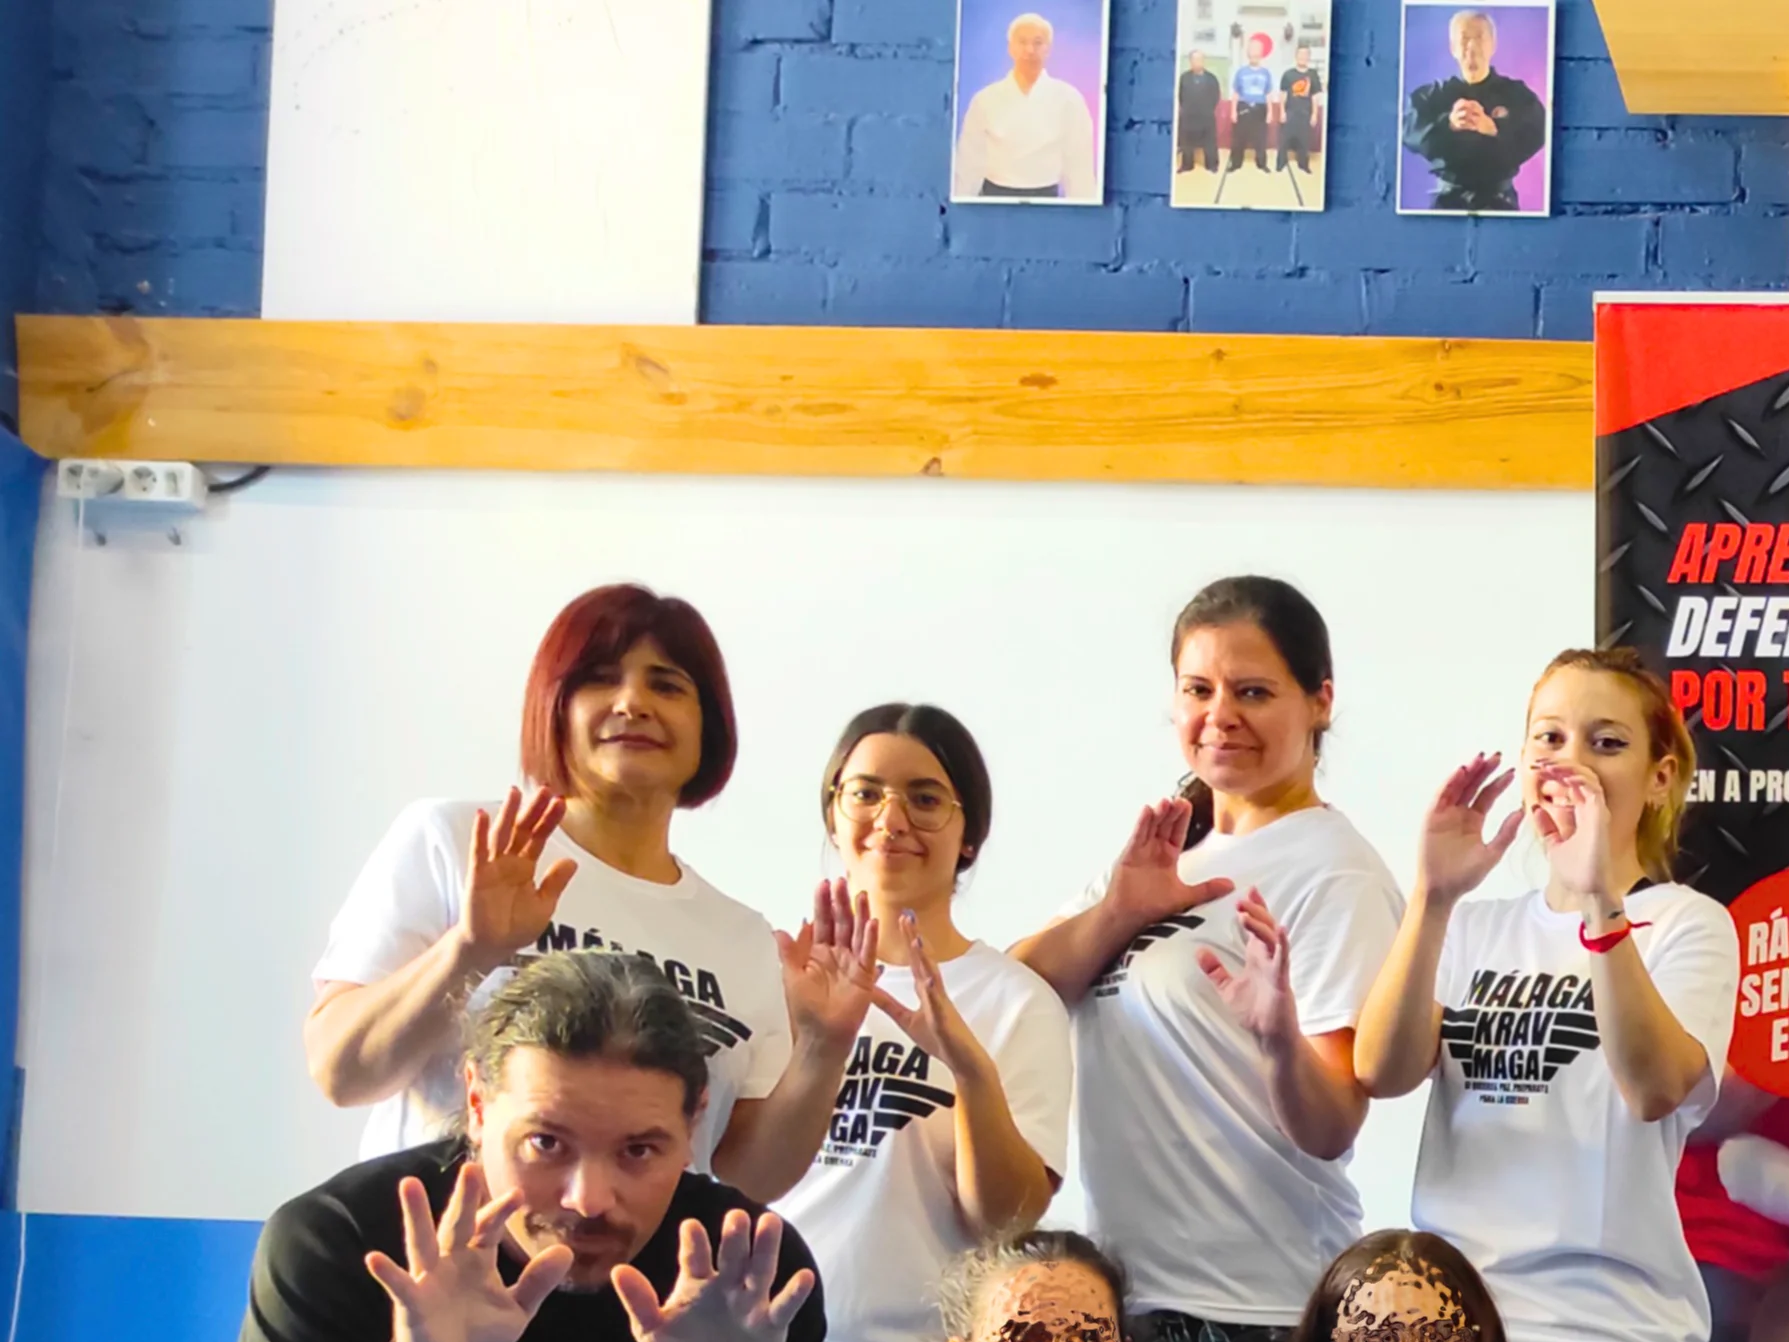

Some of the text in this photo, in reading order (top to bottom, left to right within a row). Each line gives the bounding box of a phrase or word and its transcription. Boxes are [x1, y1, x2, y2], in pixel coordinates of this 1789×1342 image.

[1671, 669, 1768, 732] POR
[1686, 769, 1717, 804] EN
[1723, 769, 1742, 803] A
[1474, 1010, 1554, 1047] KRAV
[1472, 1047, 1540, 1082] MAGA
